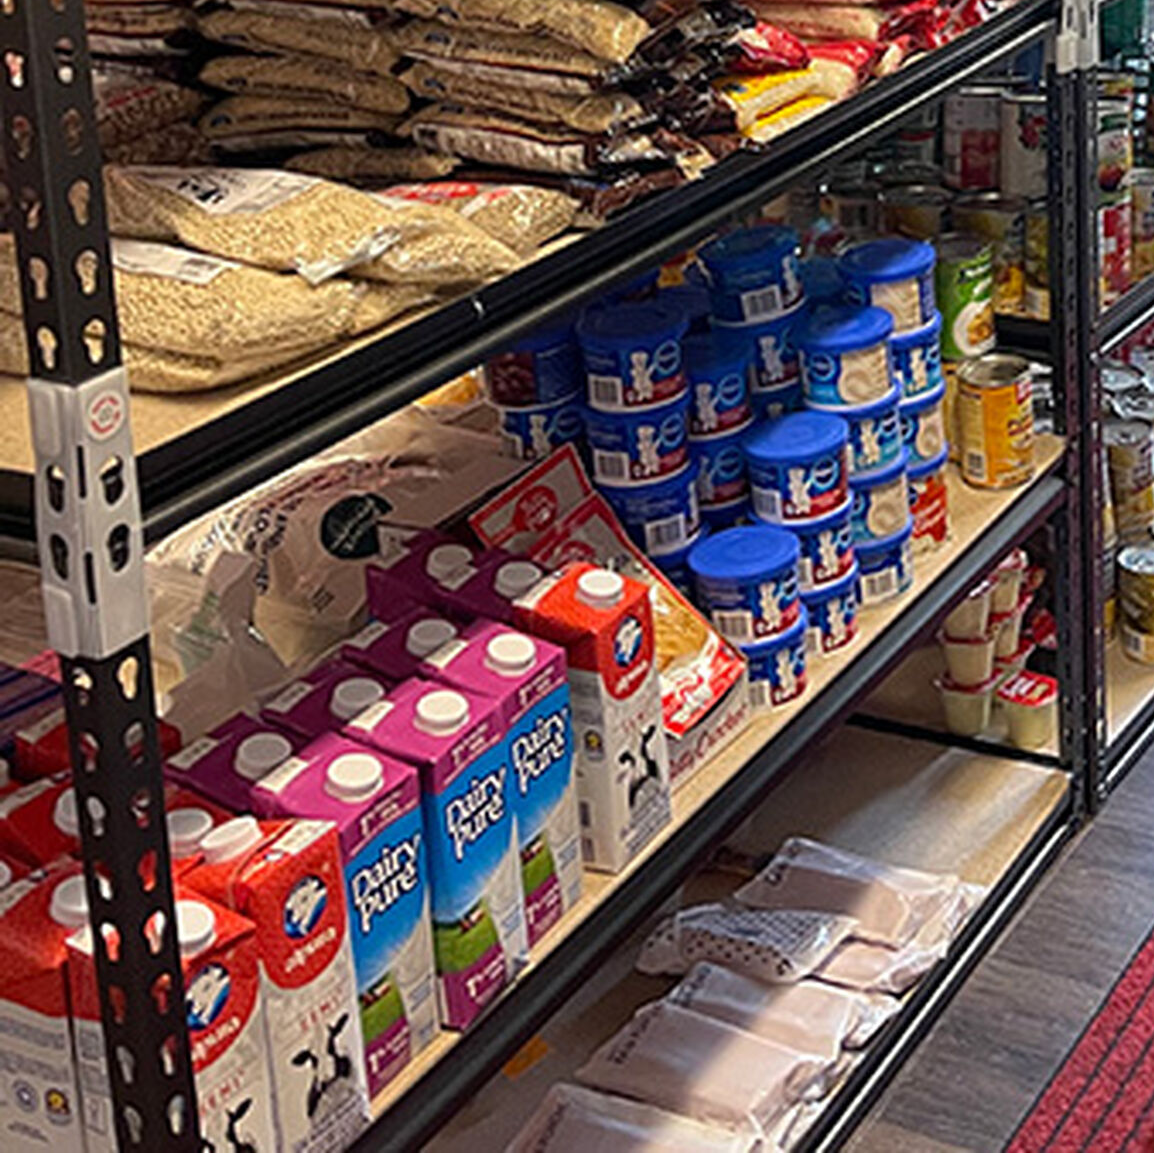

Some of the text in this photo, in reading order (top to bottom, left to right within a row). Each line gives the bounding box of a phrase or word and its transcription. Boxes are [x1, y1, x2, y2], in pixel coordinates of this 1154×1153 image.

[513, 707, 569, 764] Dairy
[446, 768, 506, 831] Dairy
[352, 834, 421, 906] Dairy
